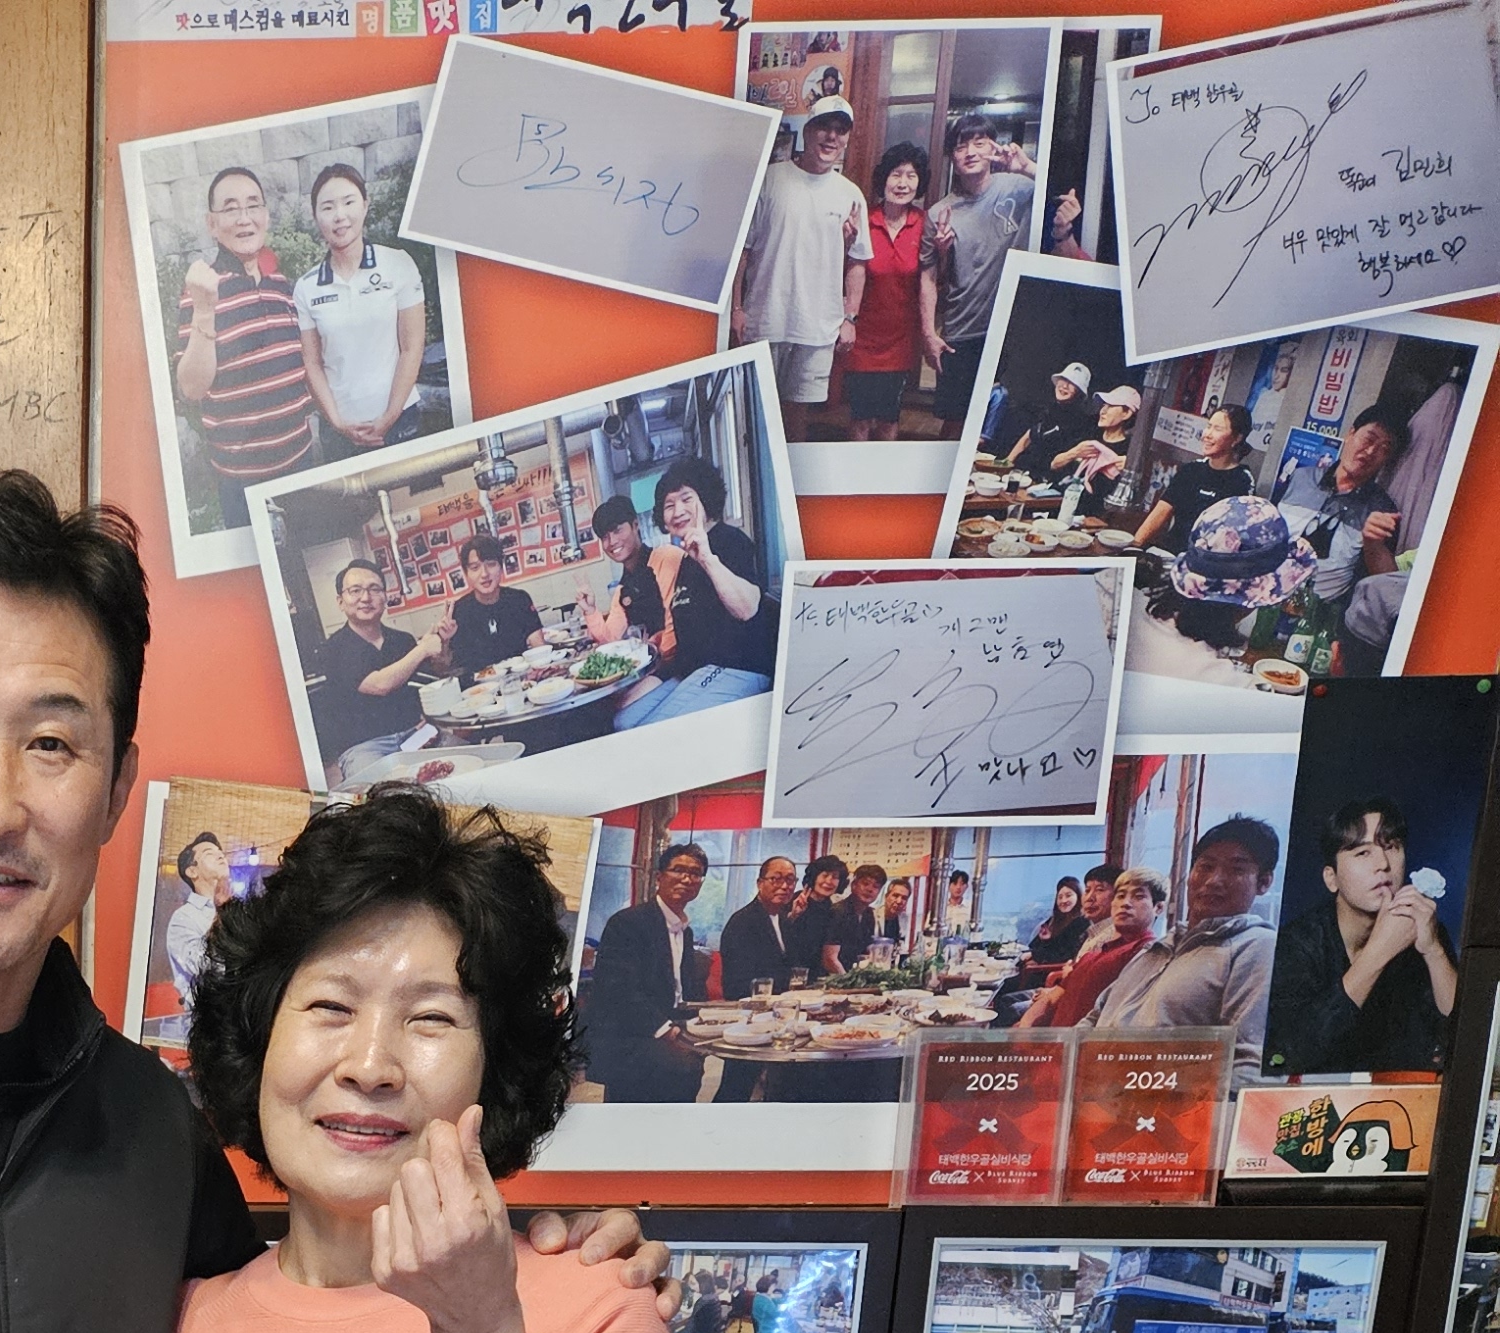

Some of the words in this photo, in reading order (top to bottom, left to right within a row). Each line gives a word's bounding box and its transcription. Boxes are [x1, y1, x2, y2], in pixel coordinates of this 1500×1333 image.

[176, 12, 220, 31] 맛으로
[224, 8, 285, 31] 매스컴을
[1381, 145, 1453, 183] 김민희
[1317, 348, 1353, 415] 비빔밥
[965, 1073, 1019, 1091] 2025
[1124, 1071, 1178, 1090] 2024
[938, 1153, 1032, 1167] 태백한우골실비식당
[1095, 1151, 1189, 1165] 태백한우골실비식당
